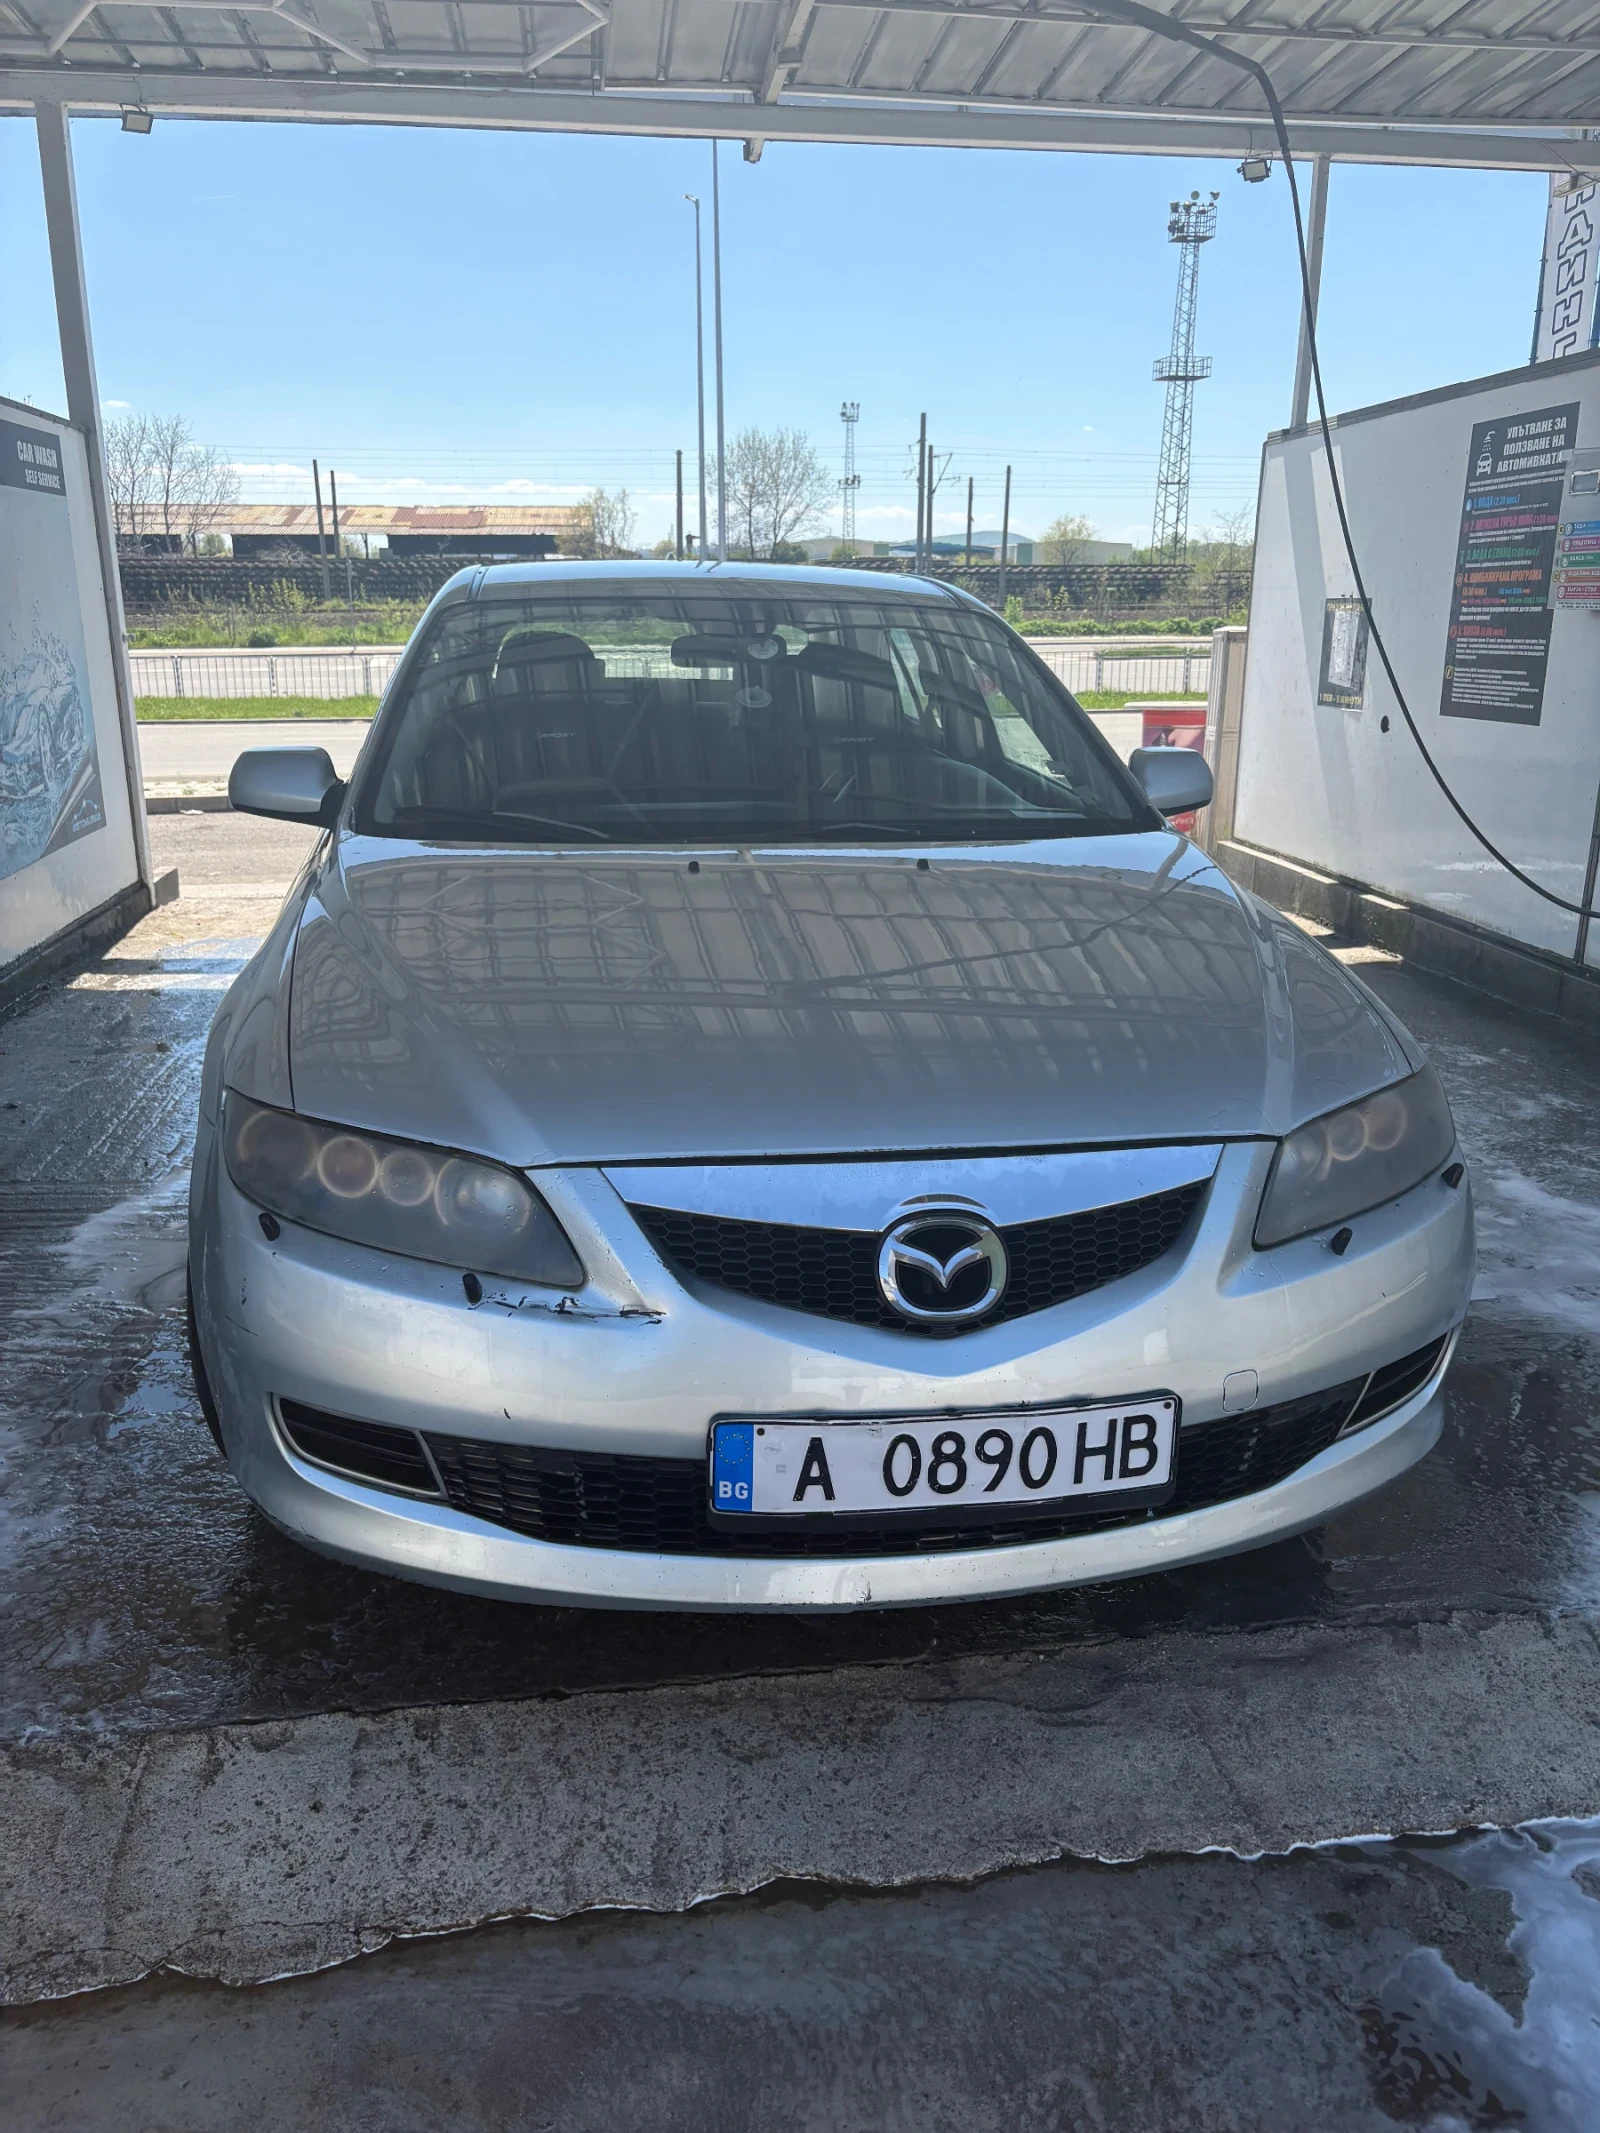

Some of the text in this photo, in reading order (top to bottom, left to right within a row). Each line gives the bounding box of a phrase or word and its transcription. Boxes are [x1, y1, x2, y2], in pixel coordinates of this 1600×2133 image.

[1507, 416, 1567, 439] УПЪТВАНЕ ЗА
[17, 440, 58, 469] CAR WASH
[1503, 434, 1565, 456] ПОЛЗВАНЕ НА
[25, 469, 61, 489] SELF SERVICE
[1510, 569, 1542, 581] ПРОГРАМА
[793, 1413, 1159, 1502] A 0890 HB
[718, 1481, 749, 1500] BG
